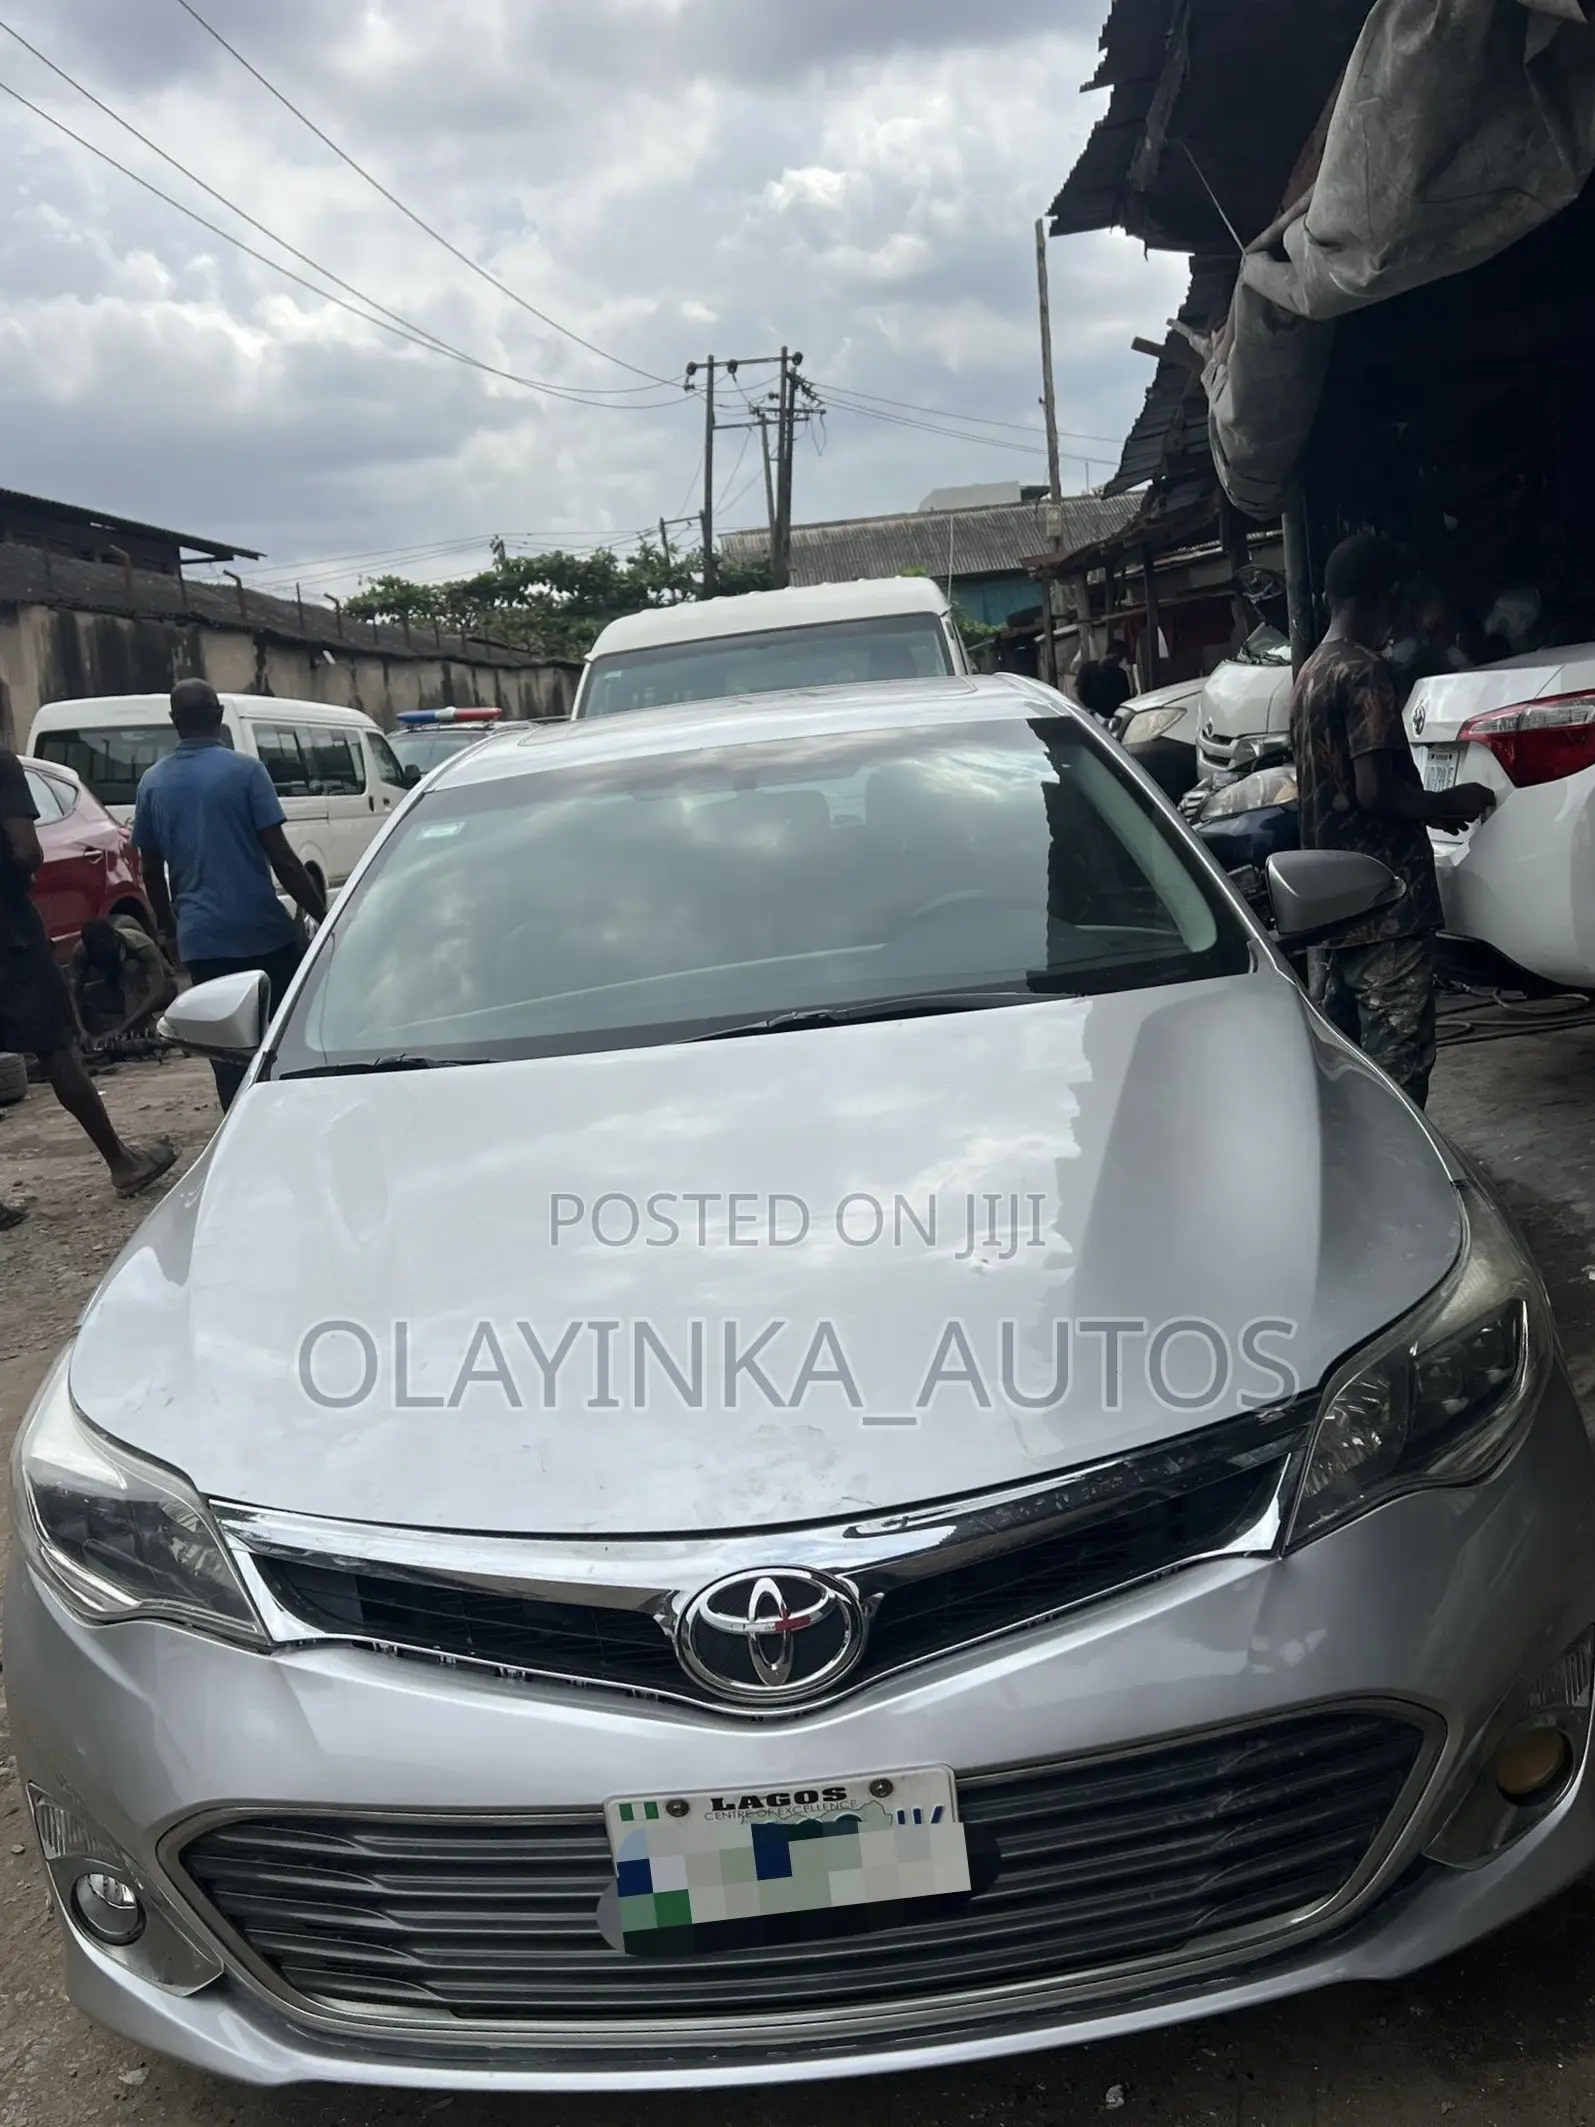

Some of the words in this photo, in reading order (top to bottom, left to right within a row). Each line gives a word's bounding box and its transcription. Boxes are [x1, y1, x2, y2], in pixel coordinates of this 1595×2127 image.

[704, 1805, 752, 1821] CENTRE
[777, 1799, 858, 1816] EXCELLENCE
[710, 1787, 848, 1811] LAGOS
